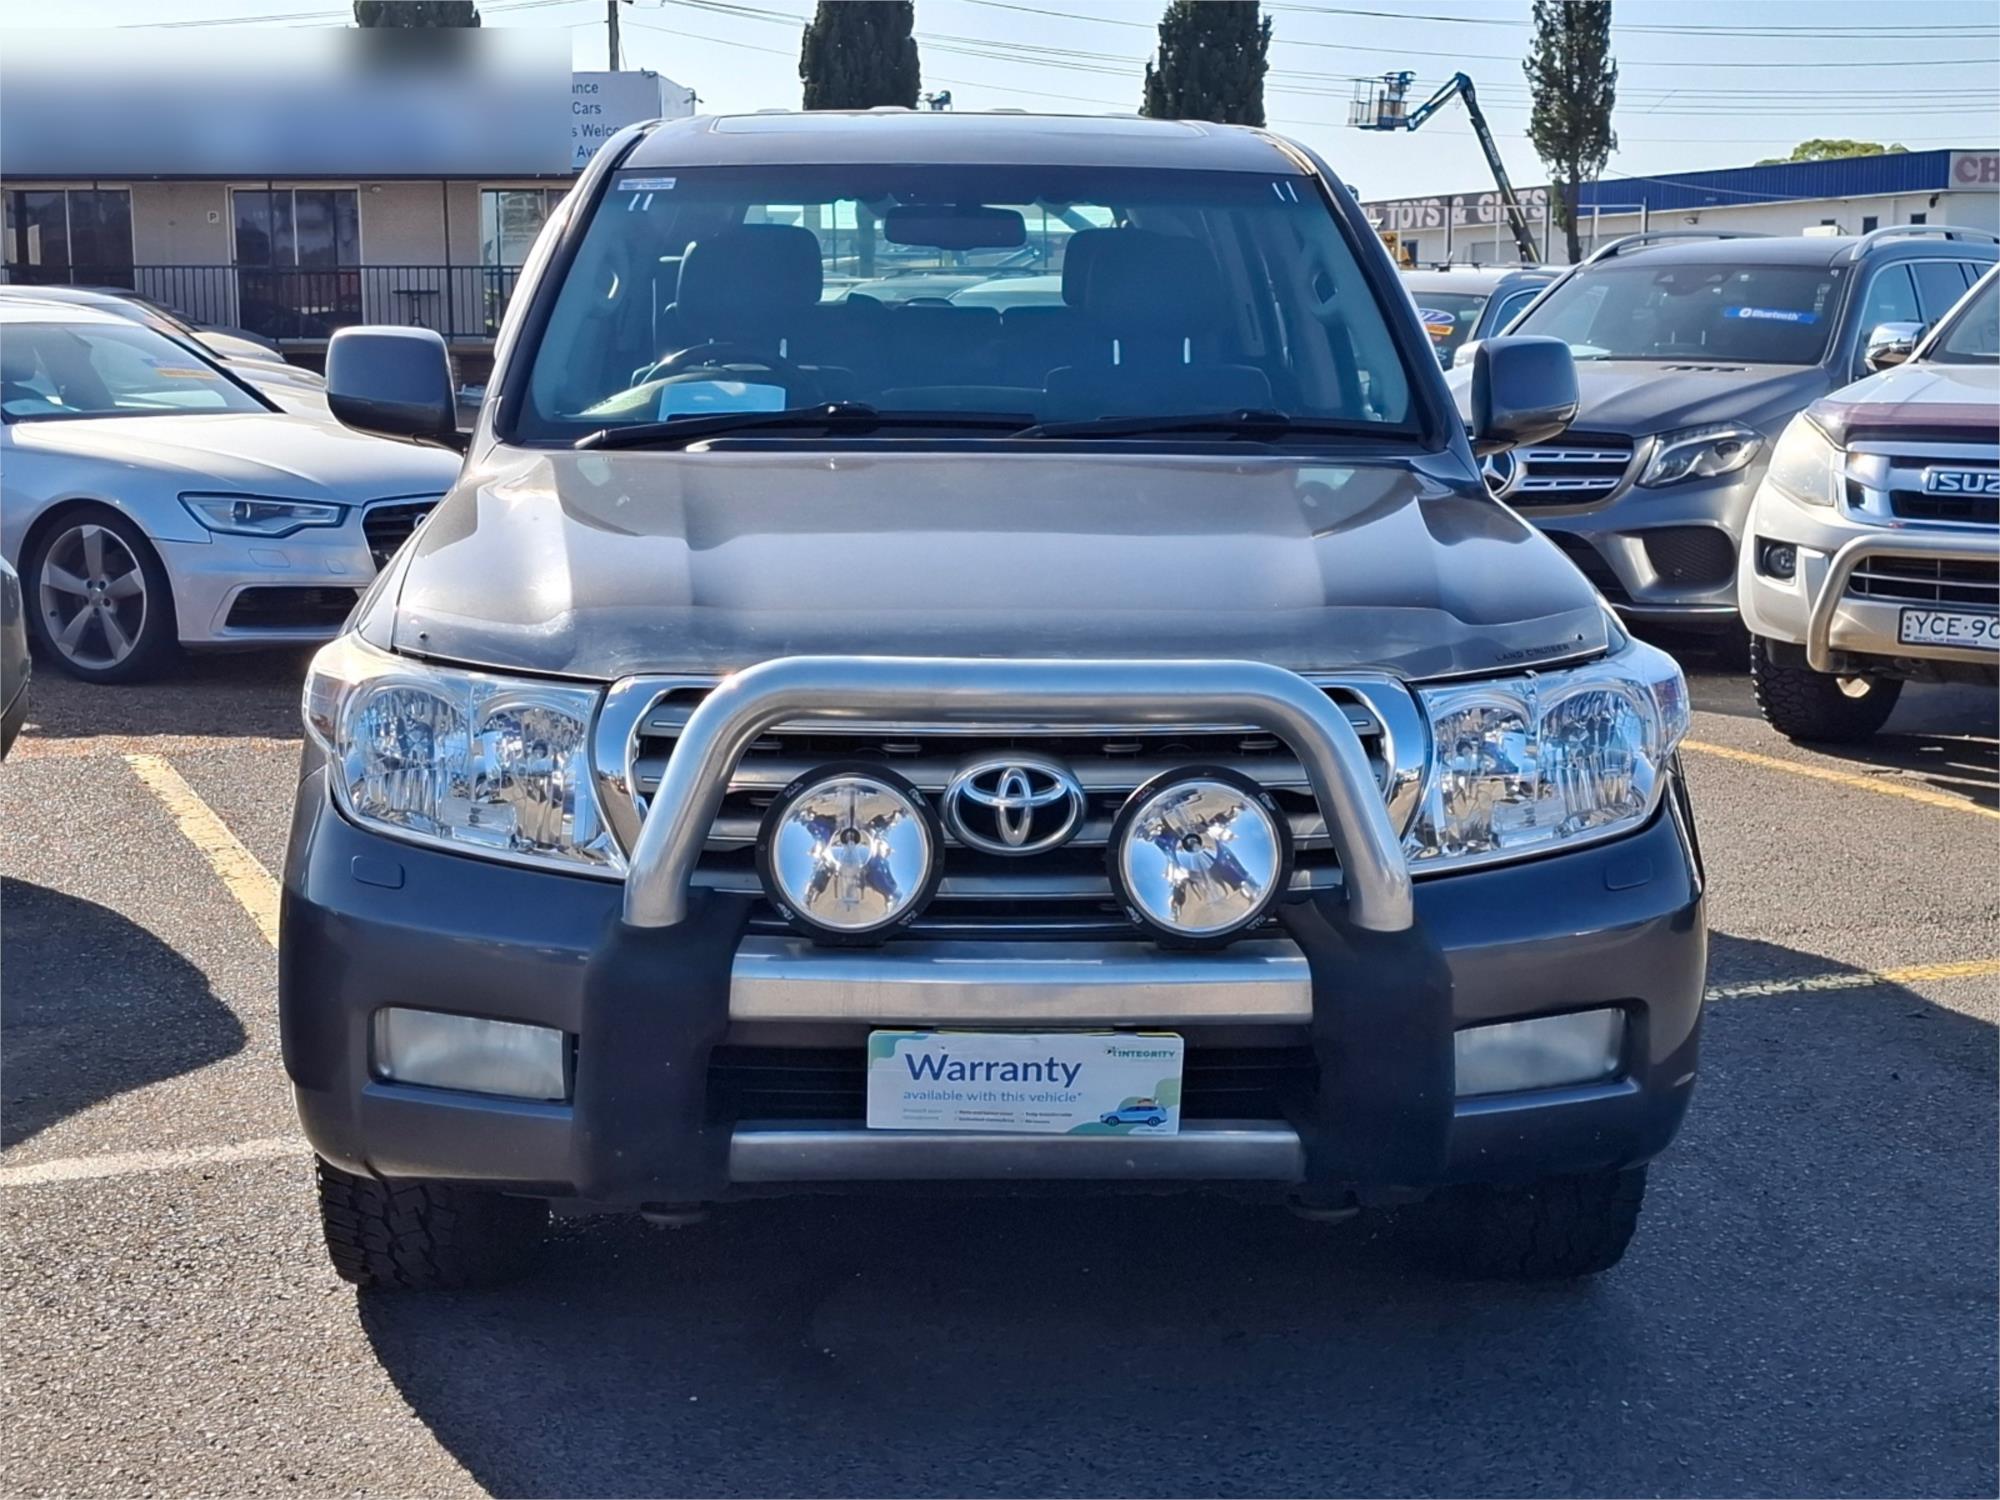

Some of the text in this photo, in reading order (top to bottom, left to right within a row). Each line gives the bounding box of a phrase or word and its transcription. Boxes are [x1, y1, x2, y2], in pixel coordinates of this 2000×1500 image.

[572, 101, 602, 115] Cars
[1386, 198, 1440, 229] TOYS
[1452, 197, 1466, 224] &
[1526, 643, 1570, 656] CRUISER
[1118, 1050, 1176, 1059] INTEGRITY
[905, 1053, 1082, 1088] Warranty
[903, 1090, 963, 1101] available
[966, 1090, 997, 1102] with
[1001, 1091, 1025, 1103] this
